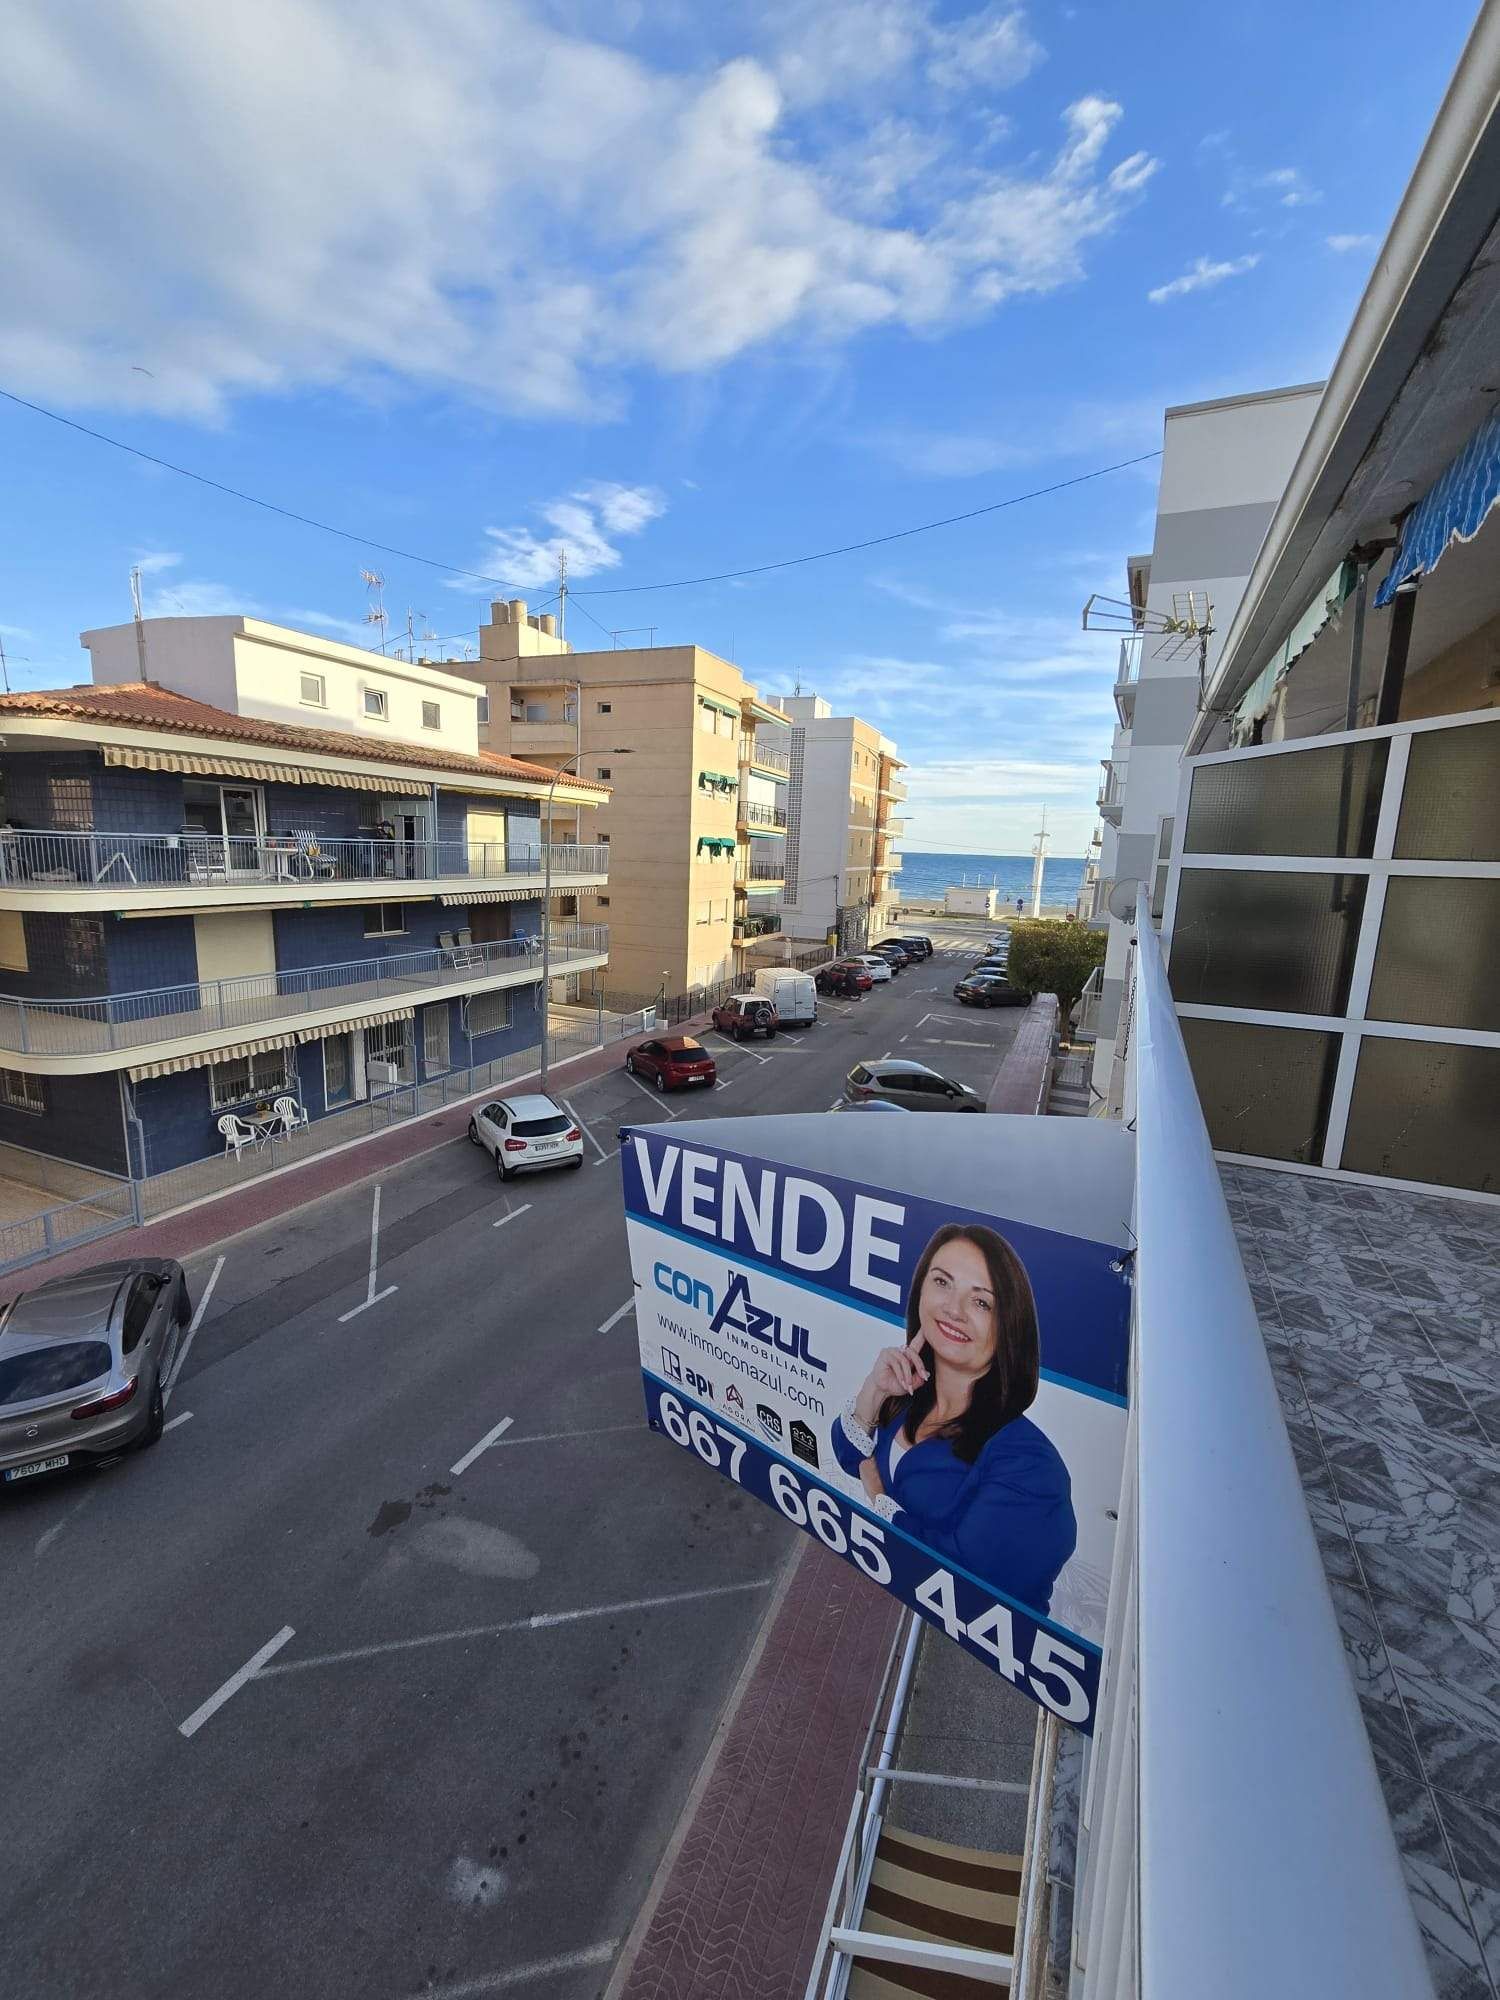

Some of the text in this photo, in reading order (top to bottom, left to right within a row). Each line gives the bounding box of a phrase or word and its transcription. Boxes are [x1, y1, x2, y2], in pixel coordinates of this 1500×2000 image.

[944, 951, 985, 960] STOP
[633, 1136, 906, 1305] VENDE
[657, 1312, 825, 1417] www.inmoconazul.com
[726, 1331, 826, 1389] INMOBILIARIA
[759, 1410, 781, 1432] CRS
[659, 1391, 1091, 1724] 667 665 445
